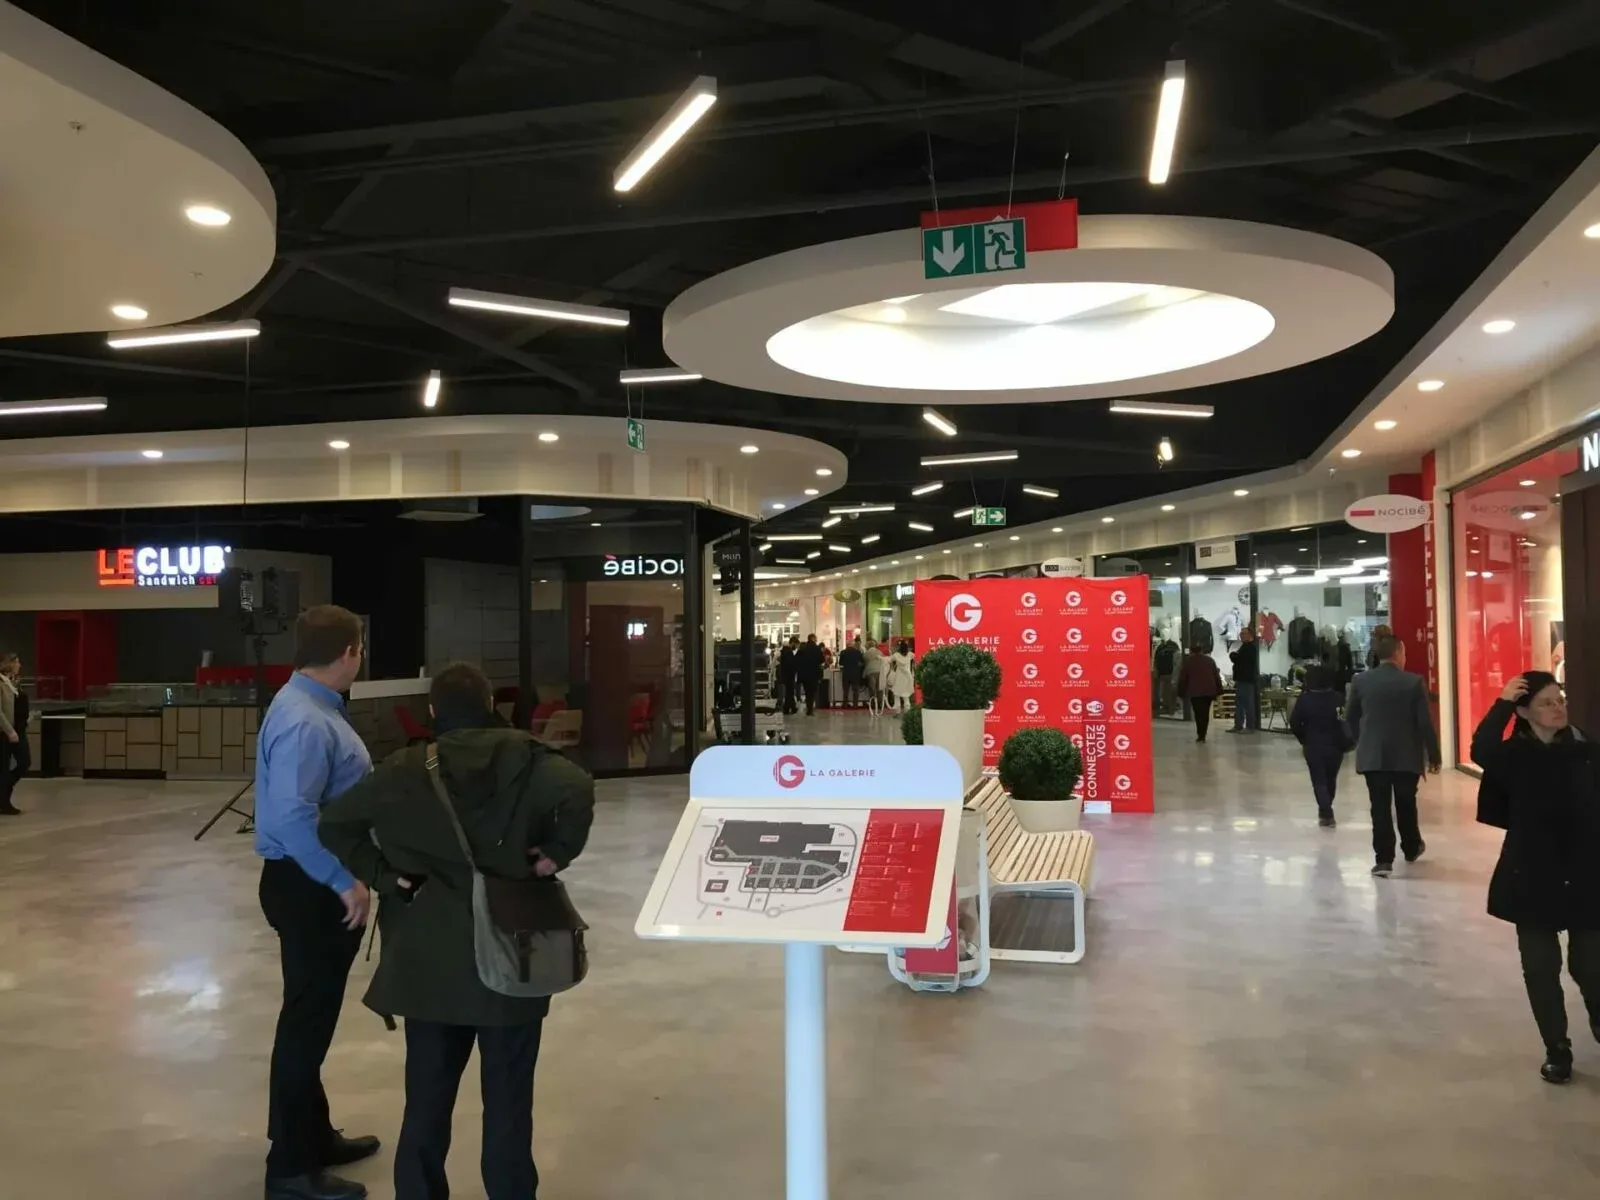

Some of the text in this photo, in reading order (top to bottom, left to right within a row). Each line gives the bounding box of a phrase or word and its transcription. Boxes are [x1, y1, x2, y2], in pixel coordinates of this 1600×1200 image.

[137, 546, 226, 575] CLUB
[138, 575, 196, 586] Sandwich
[928, 636, 1001, 645] LA GALERIE
[1096, 724, 1106, 758] VOUS
[1086, 724, 1097, 798] CONNECTEZ
[810, 769, 825, 777] LA
[828, 769, 877, 777] GALERIE
